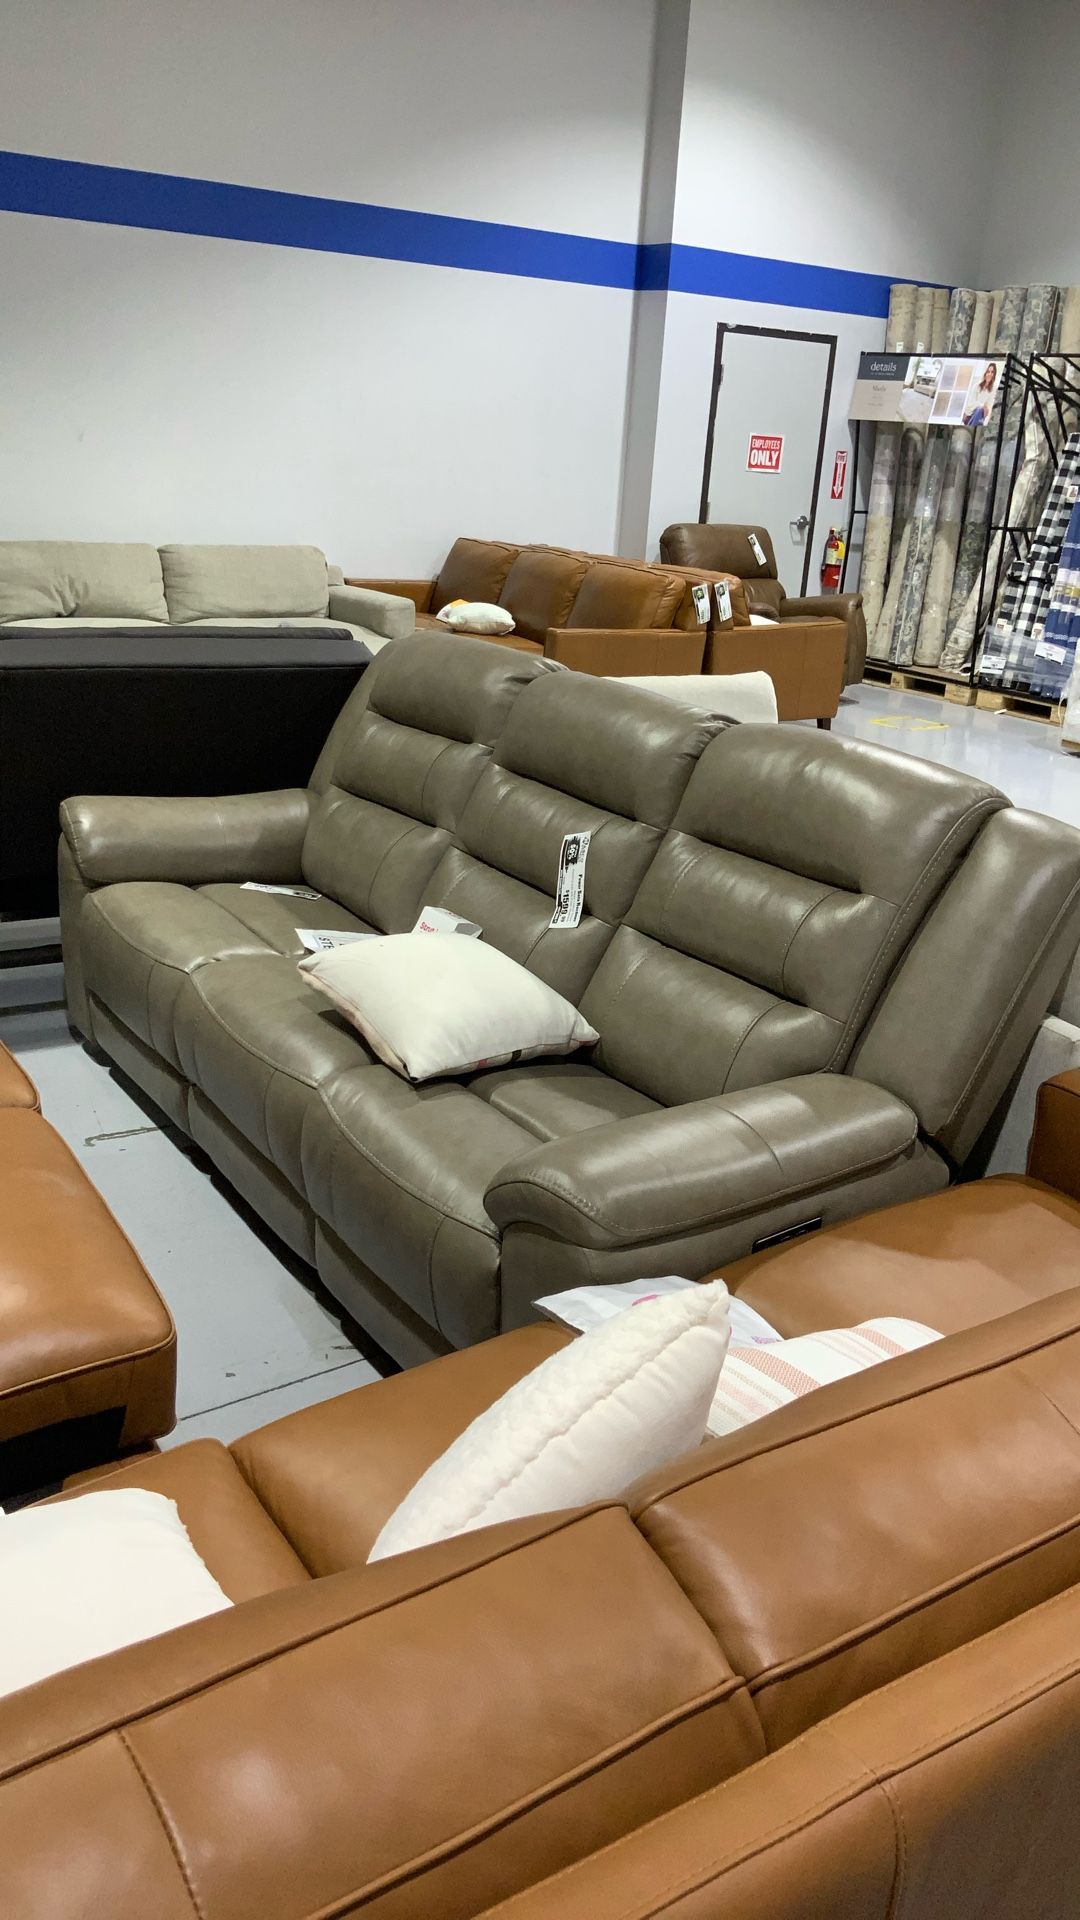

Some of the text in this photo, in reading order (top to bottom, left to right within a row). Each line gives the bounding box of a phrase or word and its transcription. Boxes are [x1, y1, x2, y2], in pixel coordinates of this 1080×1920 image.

[870, 362, 897, 372] details
[752, 438, 780, 449] EMPLOYEES
[750, 449, 779, 466] ONLY
